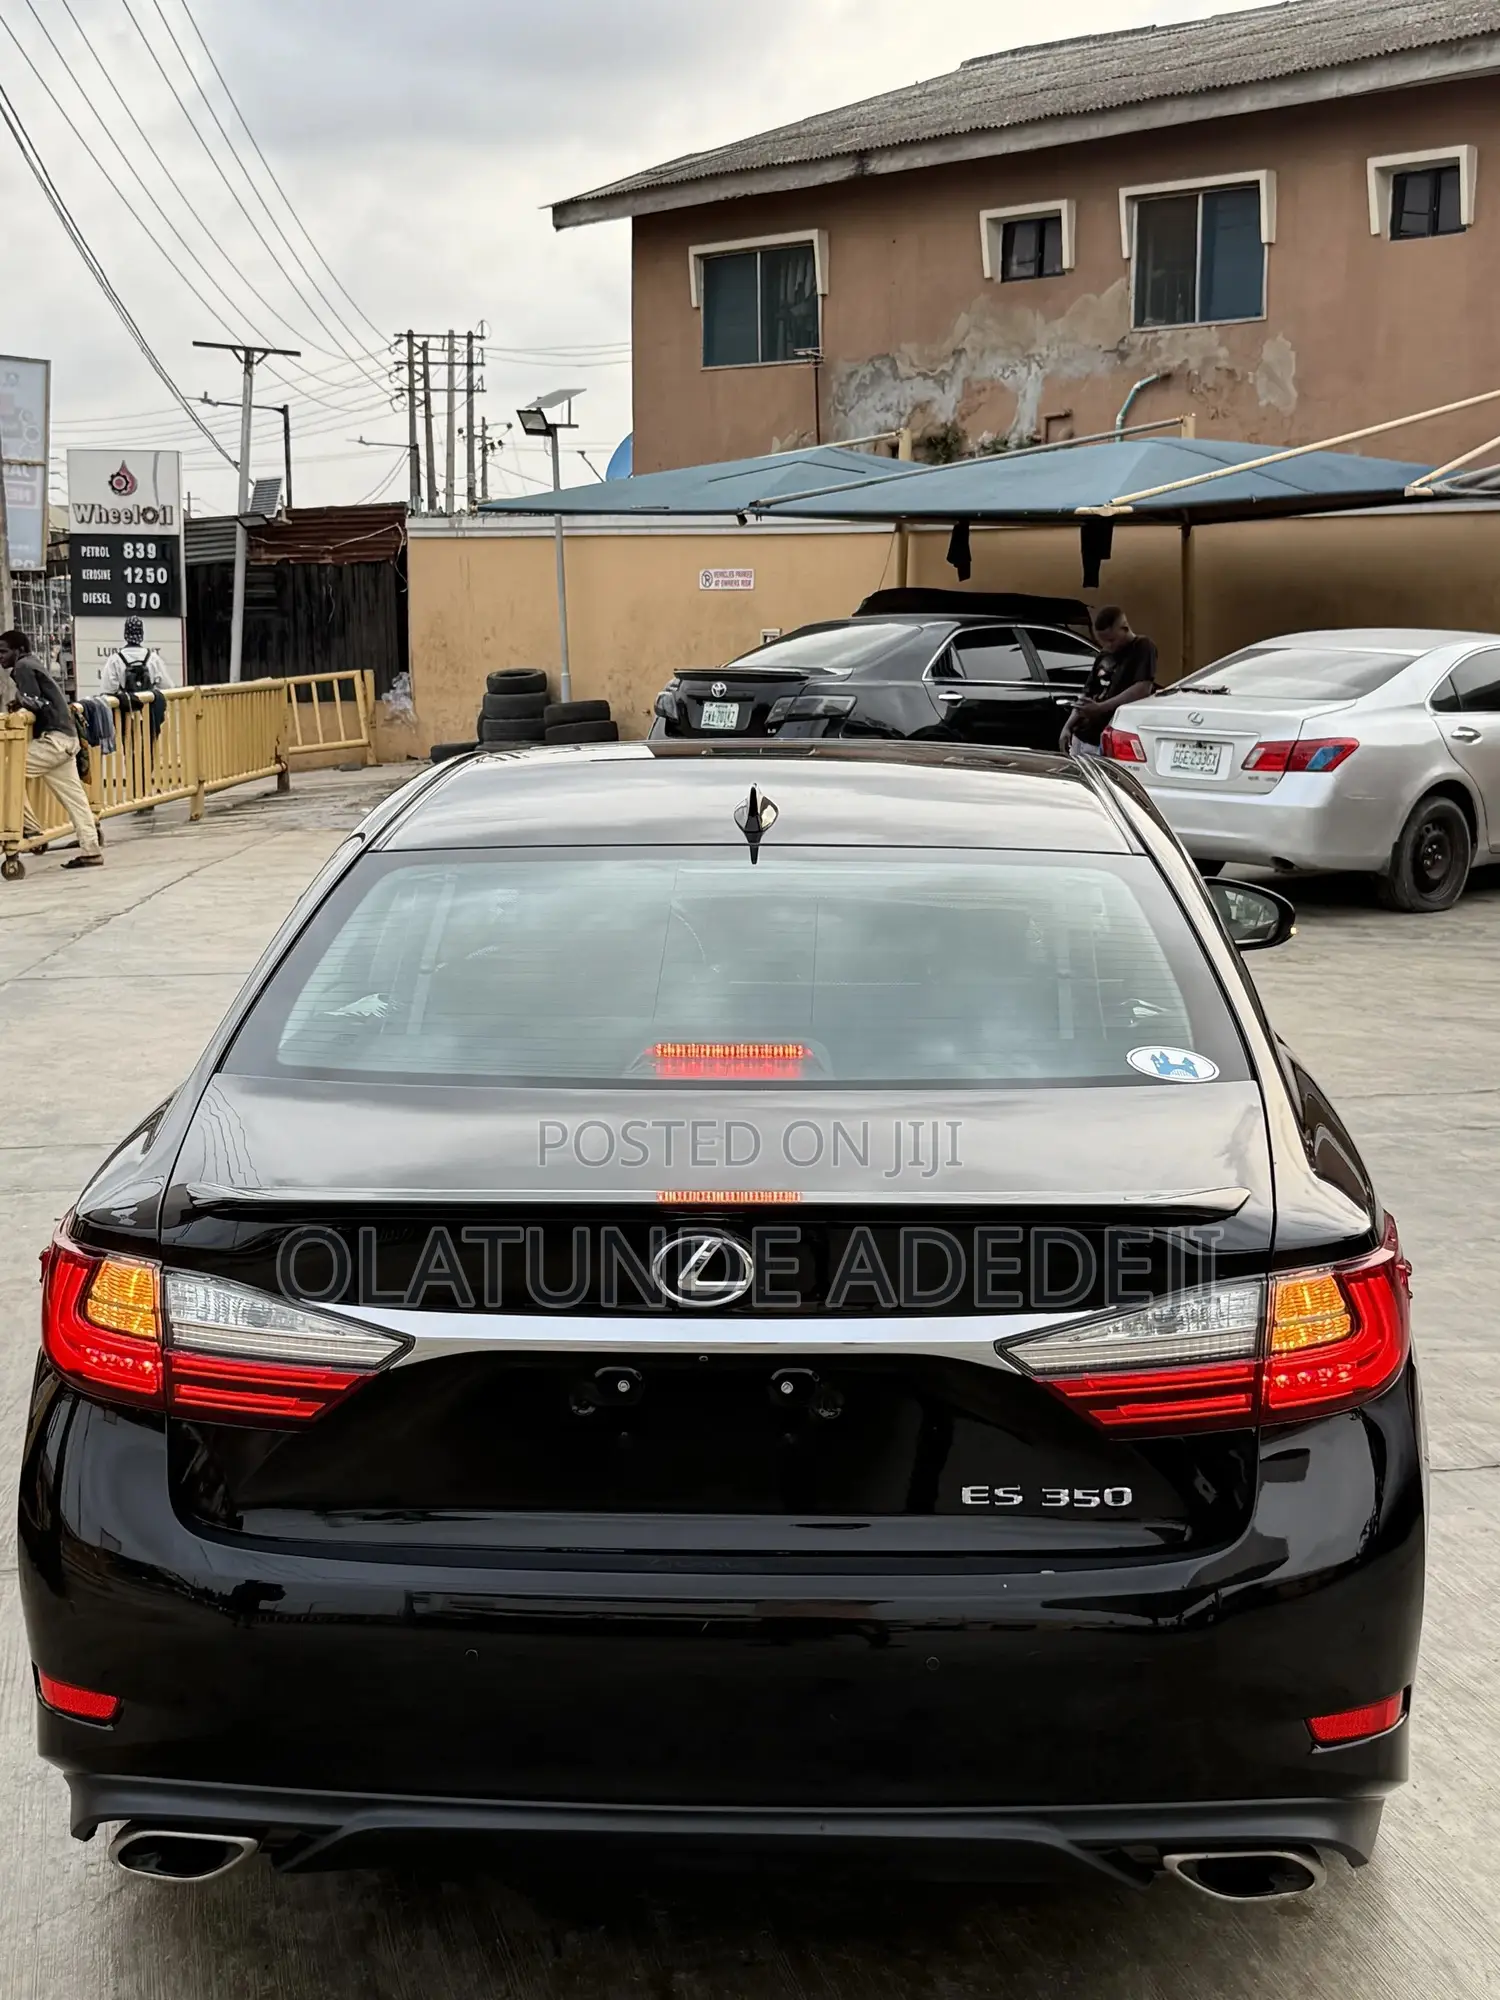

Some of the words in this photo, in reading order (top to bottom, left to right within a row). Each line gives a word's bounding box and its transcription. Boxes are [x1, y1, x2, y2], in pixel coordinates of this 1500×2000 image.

[72, 503, 173, 525] WheelOil
[81, 545, 110, 558] PETROL
[123, 542, 157, 559] 839
[82, 569, 111, 581] KEROSINE
[123, 566, 168, 584] 1250
[82, 592, 112, 605] DIESEL
[126, 592, 161, 610] 970
[961, 1485, 1024, 1506] ES
[1041, 1486, 1133, 1508] 350
